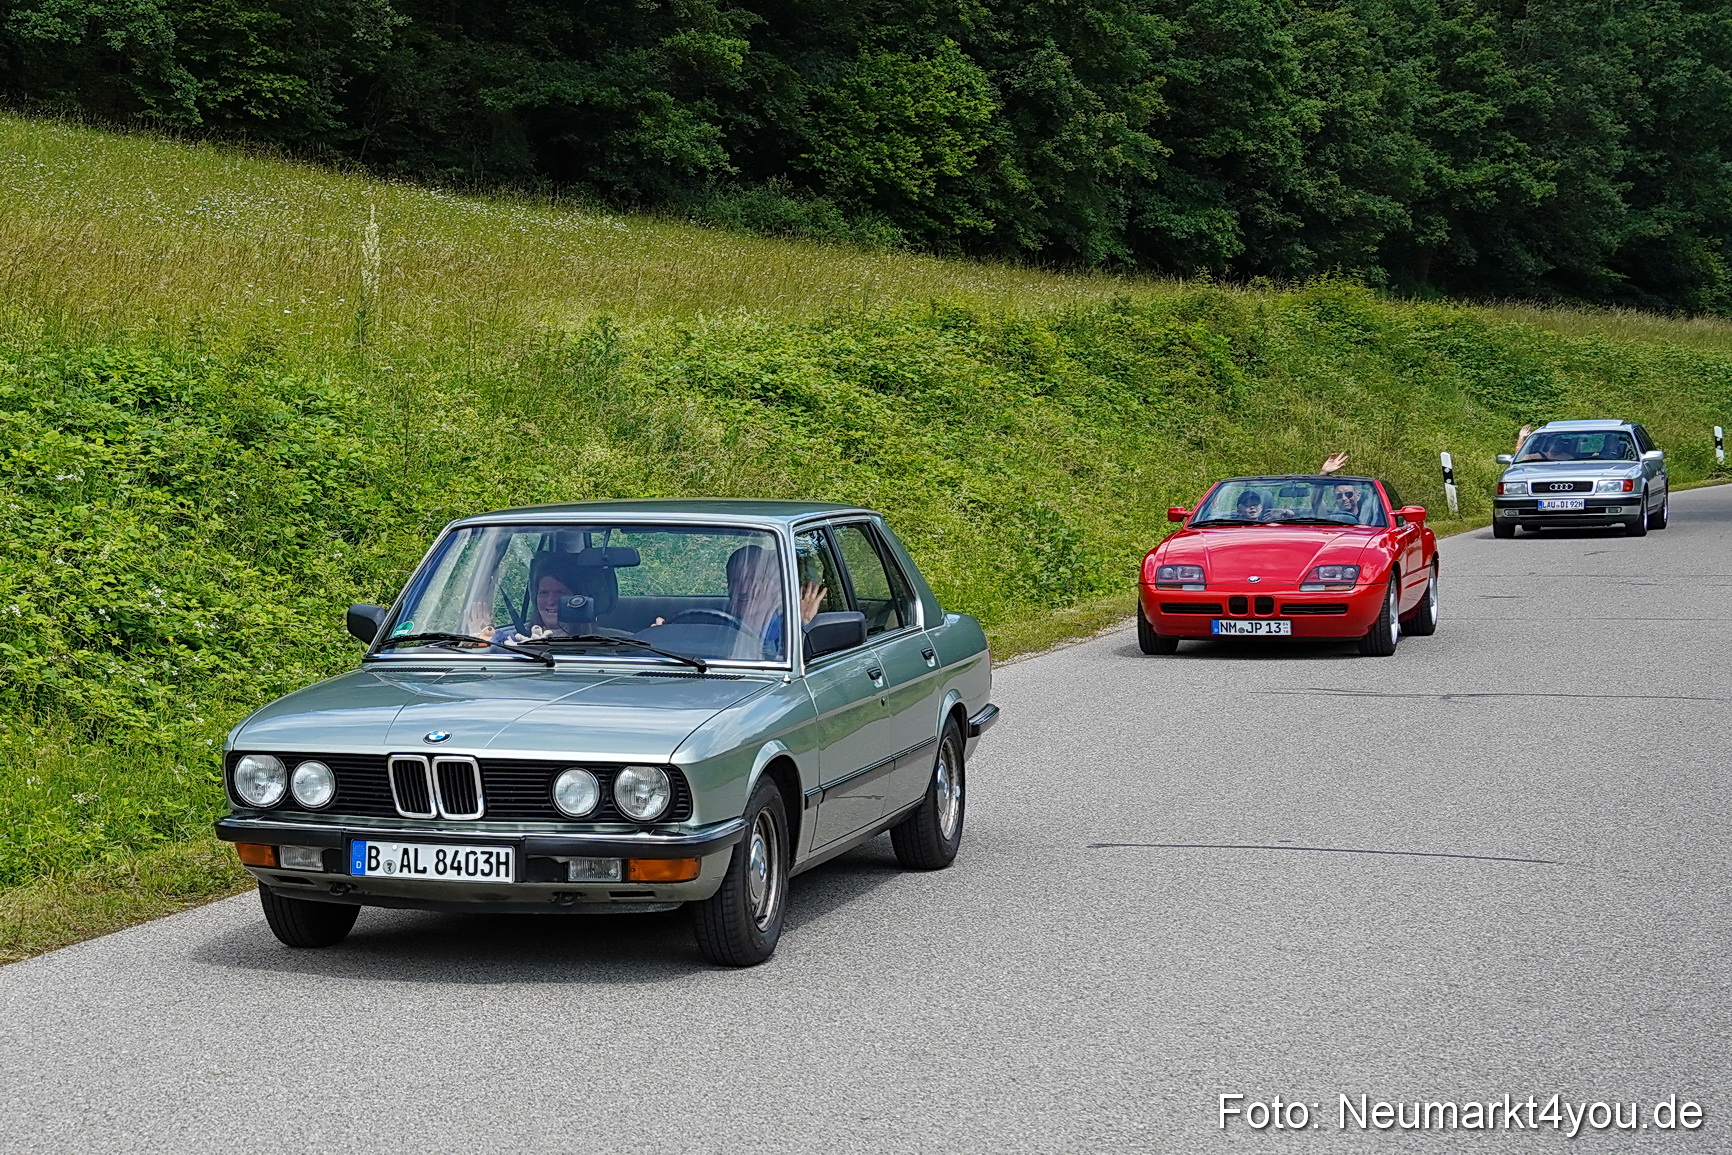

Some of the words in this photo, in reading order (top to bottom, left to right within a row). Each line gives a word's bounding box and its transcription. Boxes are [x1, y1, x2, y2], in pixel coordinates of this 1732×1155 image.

[1543, 501, 1555, 509] LAU
[1220, 622, 1237, 633] NM
[1246, 622, 1262, 633] JP
[1265, 622, 1281, 634] 13
[355, 861, 362, 869] D
[367, 845, 381, 871] B
[399, 848, 427, 874] AL
[434, 849, 510, 878] 8403H
